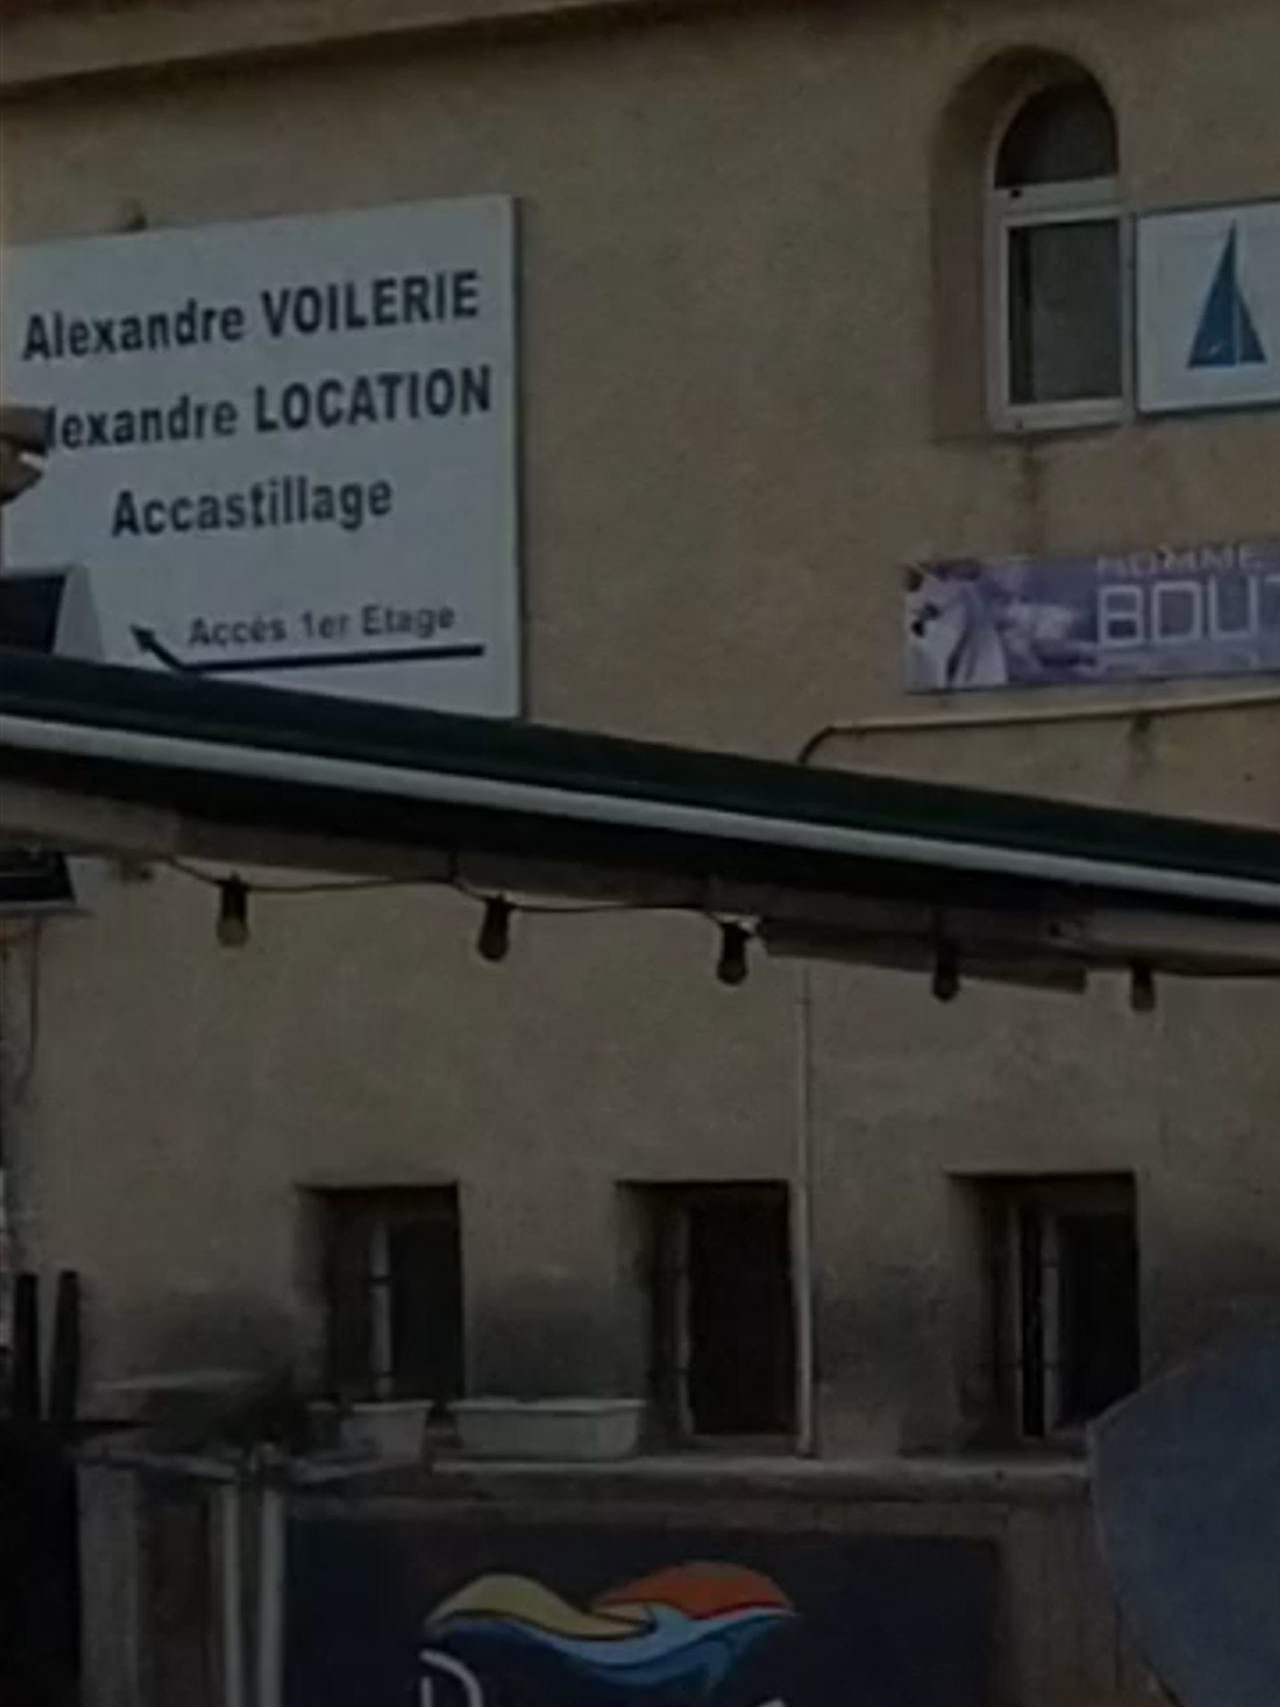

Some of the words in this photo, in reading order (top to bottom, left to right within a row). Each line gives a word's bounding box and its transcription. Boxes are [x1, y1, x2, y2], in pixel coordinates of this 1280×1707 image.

[21, 297, 245, 362] Alexandre
[261, 270, 479, 338] VOILERIE
[46, 395, 238, 450] lexandre
[254, 364, 493, 434] LOCATION
[110, 475, 395, 537] Accastillage
[302, 610, 352, 640] 1er
